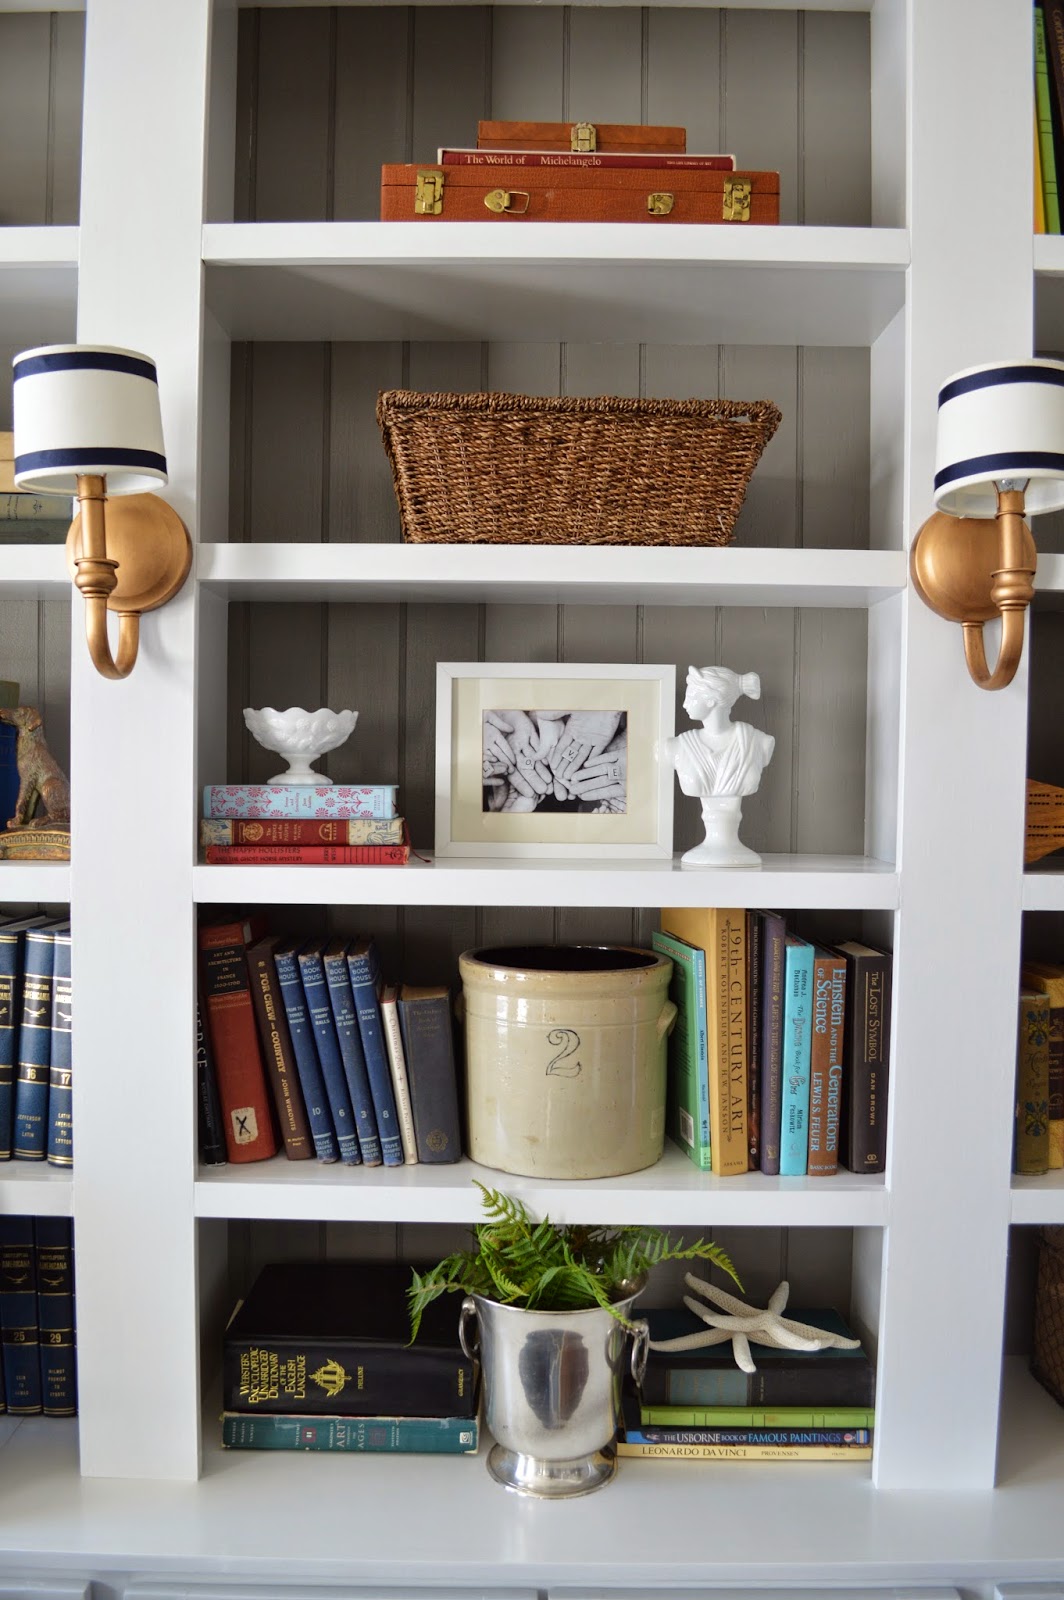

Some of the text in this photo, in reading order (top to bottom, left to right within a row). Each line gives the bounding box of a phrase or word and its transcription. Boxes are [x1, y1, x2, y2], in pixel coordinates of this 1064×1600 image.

[465, 154, 601, 167] The World of Michelangelo
[613, 769, 618, 777] E
[279, 965, 296, 973] BOOK
[698, 979, 703, 987] OF
[800, 969, 808, 991] Andrea
[815, 967, 832, 1034] OF Science
[771, 1004, 779, 1021] LIFE
[868, 971, 881, 1063] The LOST SYMBOL
[771, 1031, 779, 1046] THE
[259, 972, 298, 1132] FOR CREW COUNTRY JOHN WUKOVITS
[545, 1028, 583, 1078] 2
[720, 1041, 728, 1064] AND
[826, 968, 847, 1152] Einstein AND THE Generations
[26, 1067, 37, 1080] 16
[61, 1072, 71, 1085] 17
[770, 1063, 777, 1073] OF
[312, 1107, 321, 1116] 10
[338, 1108, 345, 1117] 6
[360, 1110, 367, 1119] 3
[382, 1110, 389, 1118] 8
[731, 1095, 744, 1134] ART
[788, 1104, 797, 1134] Peskowitz
[796, 1109, 804, 1130] Miriam
[810, 1072, 823, 1152] LEWIS S. FEUER
[235, 1115, 251, 1137] X
[13, 1331, 26, 1342] 25
[49, 1332, 62, 1344] 29
[240, 1353, 250, 1395] WEBSTER'S
[248, 1346, 260, 1403] ENCYCLOPEDIC
[259, 1349, 269, 1400] UNABRIDGED
[268, 1351, 279, 1399] DICTIONARY
[280, 1378, 287, 1386] OF
[285, 1359, 296, 1393] ENGLISH
[294, 1354, 306, 1399] LANGUAGE
[336, 1423, 346, 1447] ART
[357, 1423, 365, 1449] AGES
[676, 1433, 721, 1443] USBORNE
[748, 1433, 788, 1443] FAMOUS
[790, 1433, 841, 1443] PAINTINGS
[642, 1446, 700, 1456] LEONARDO
[702, 1448, 716, 1456] DA
[717, 1448, 747, 1457] VINCI
